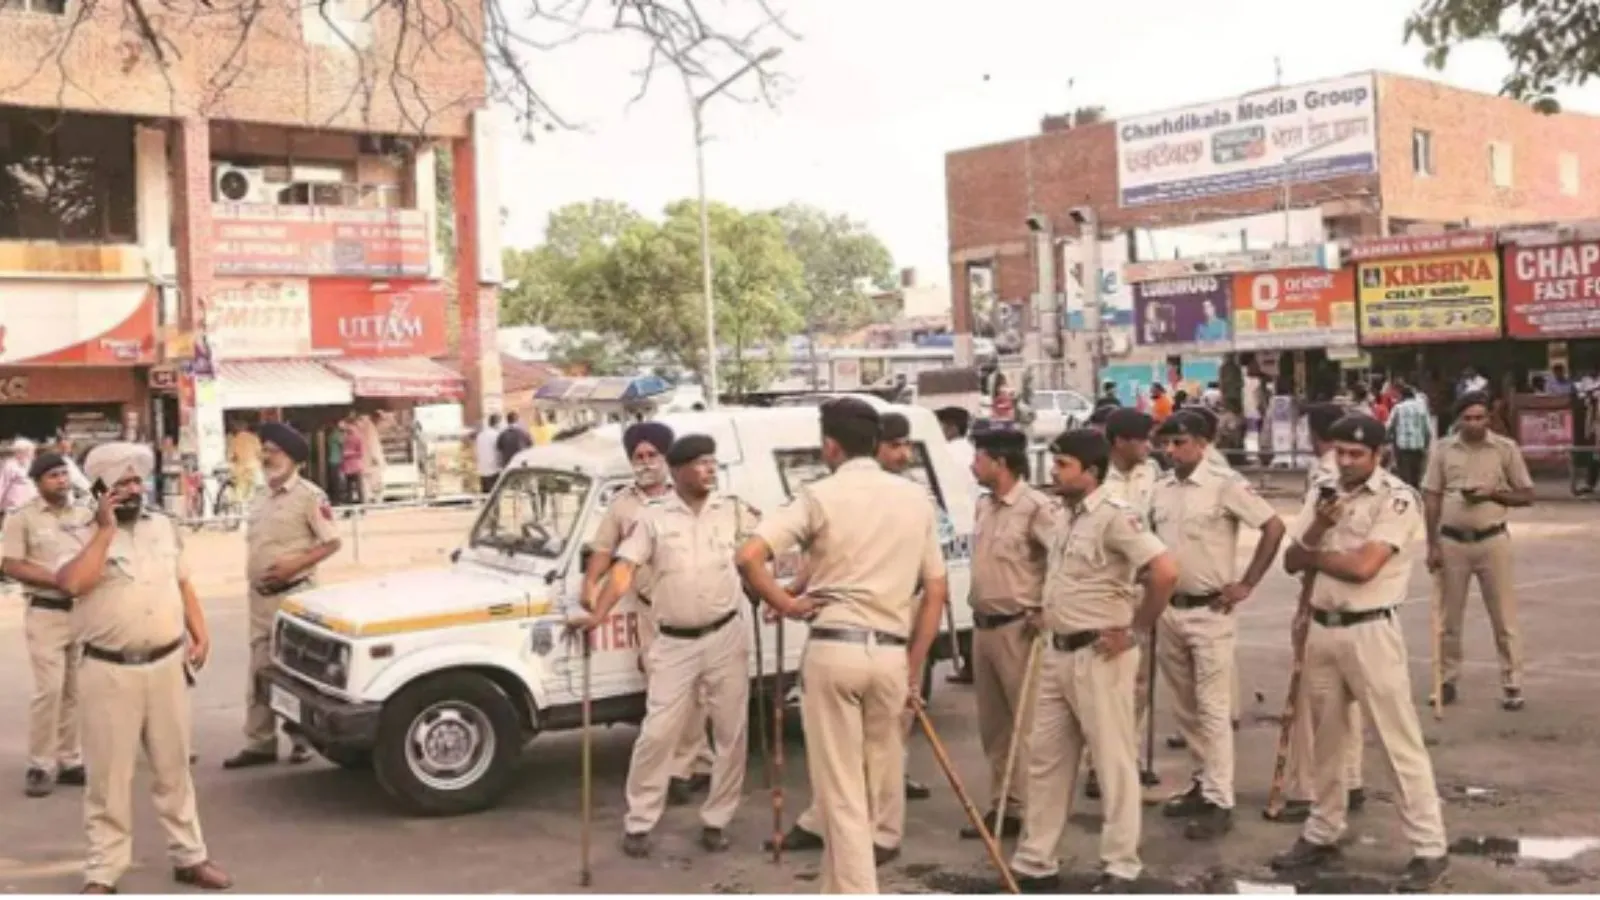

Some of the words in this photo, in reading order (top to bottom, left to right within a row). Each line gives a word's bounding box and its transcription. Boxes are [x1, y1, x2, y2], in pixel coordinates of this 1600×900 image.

[1121, 107, 1231, 142] Charhdikala
[1237, 96, 1296, 121] Media
[1304, 87, 1367, 110] Group
[1384, 257, 1493, 288] KRISHNA
[1384, 288, 1426, 300] CHAT
[1533, 278, 1578, 301] FAST
[338, 314, 423, 339] UTTAM
